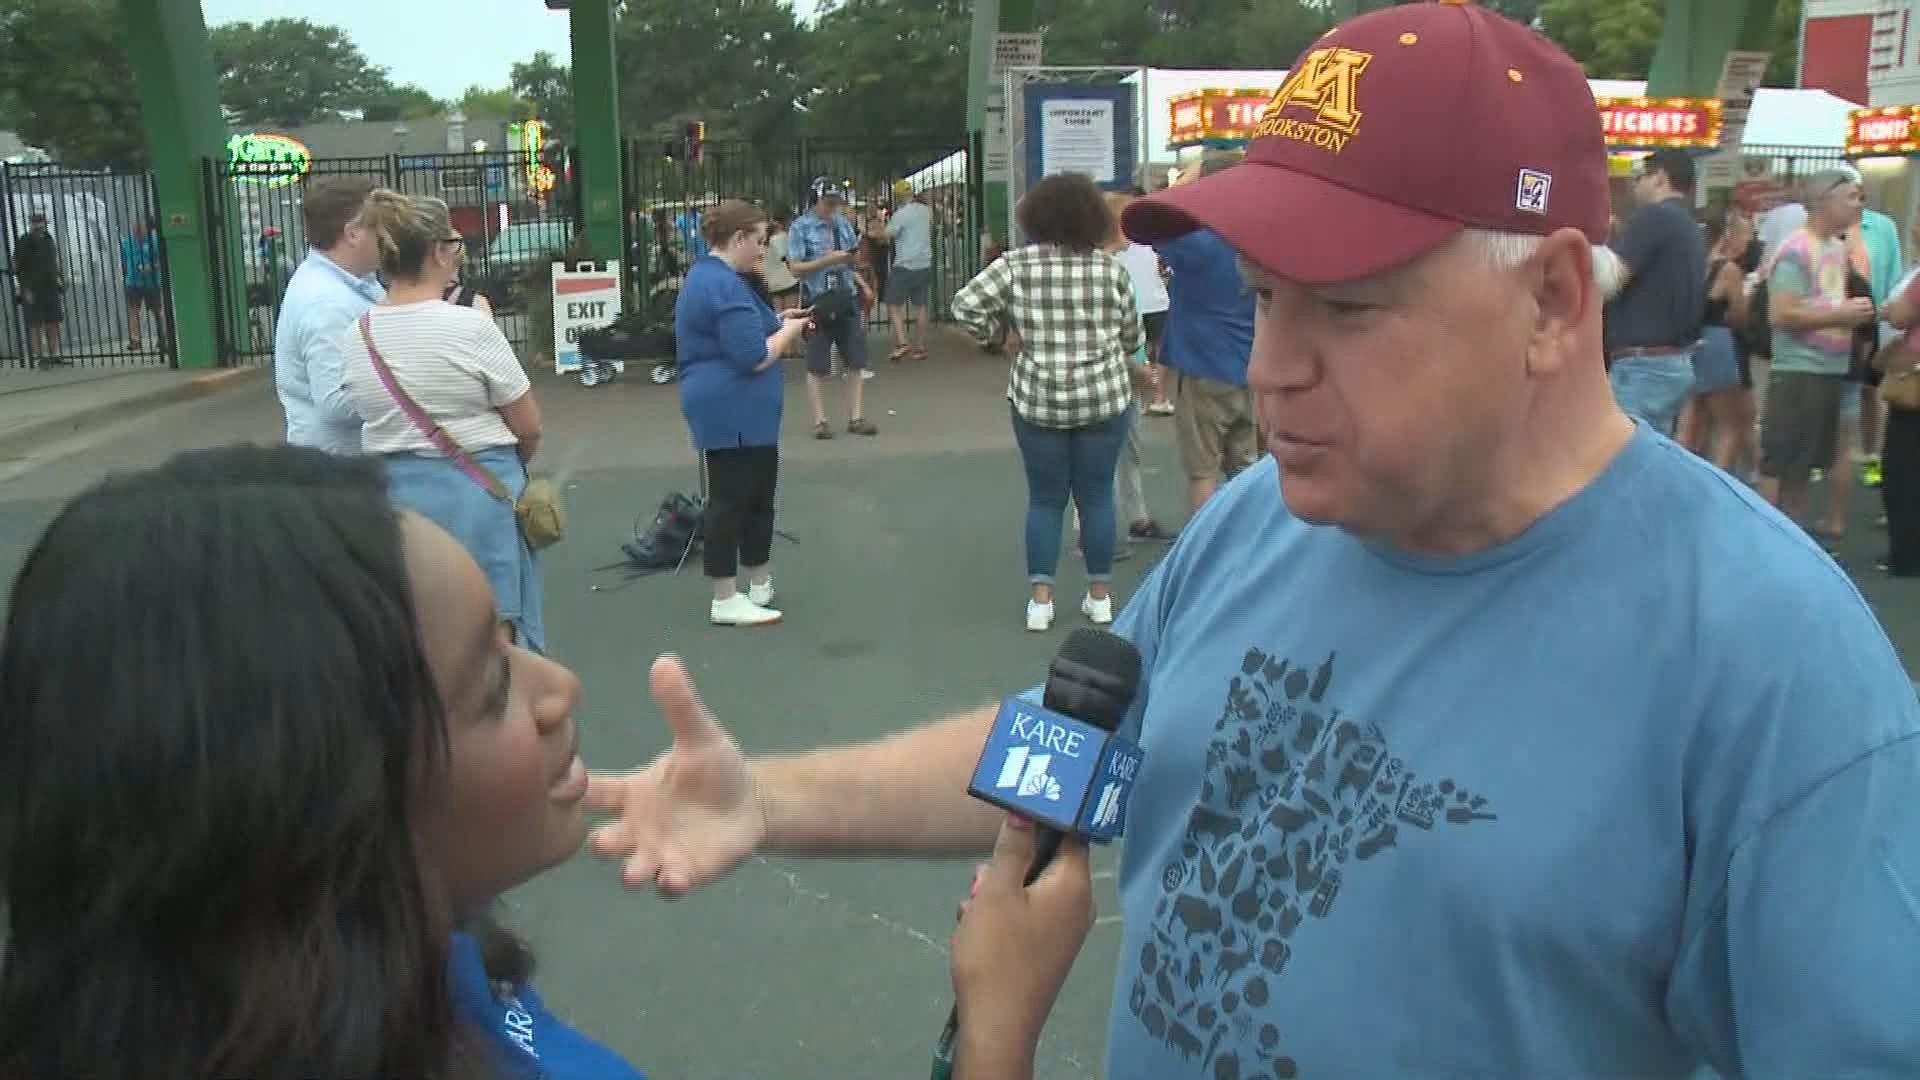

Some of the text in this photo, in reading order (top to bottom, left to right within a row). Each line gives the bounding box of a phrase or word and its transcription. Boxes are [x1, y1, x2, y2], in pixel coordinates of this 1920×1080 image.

[1601, 111, 1697, 133] TICKETS
[567, 301, 606, 320] EXIT
[1010, 712, 1086, 758] KARE
[1108, 751, 1139, 782] KARE
